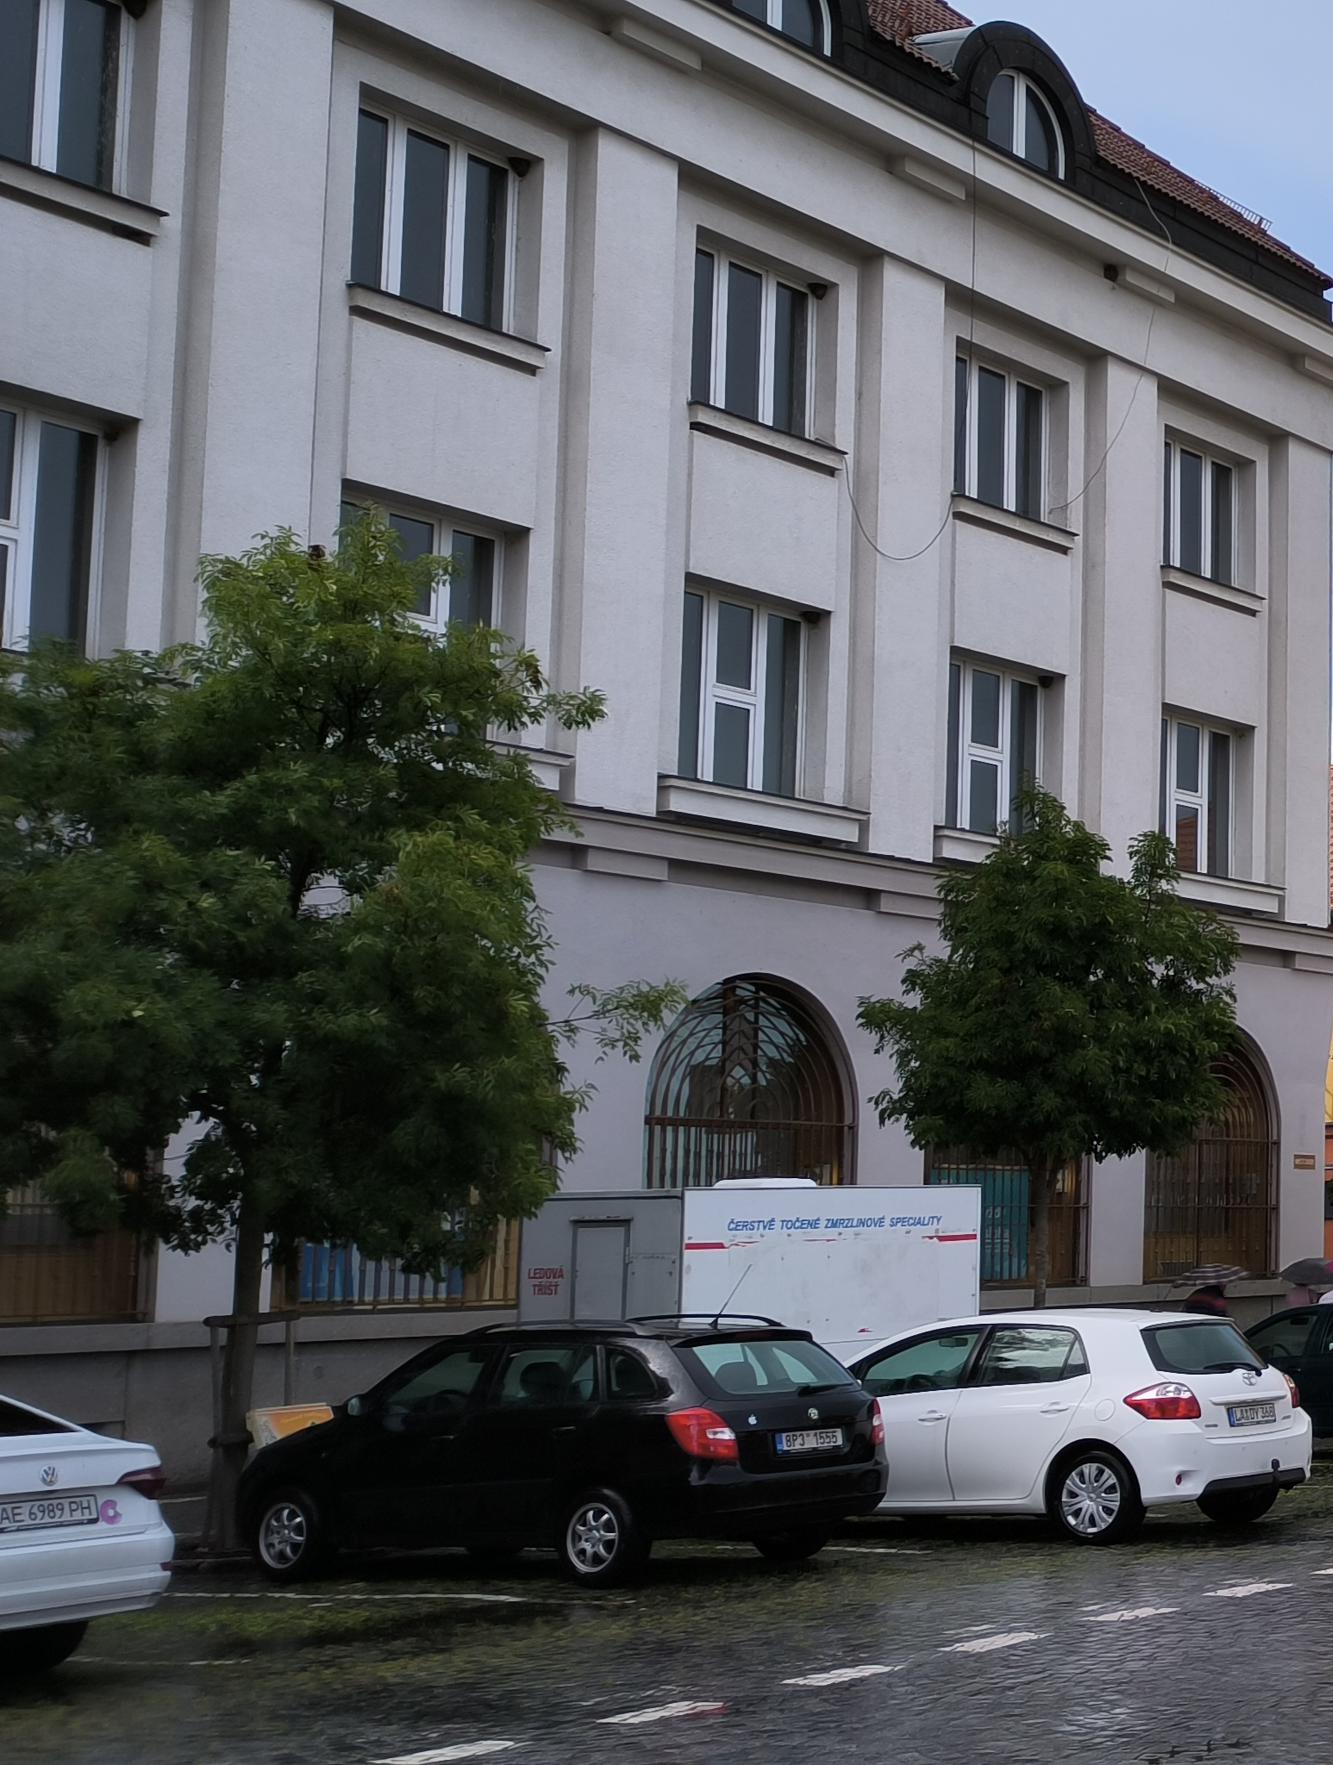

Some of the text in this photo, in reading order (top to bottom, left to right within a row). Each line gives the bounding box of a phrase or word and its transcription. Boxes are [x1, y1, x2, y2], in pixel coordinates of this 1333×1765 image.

[779, 1216, 822, 1231] TOČENÉ
[824, 1215, 886, 1230] ZMRZLINOVÉ
[888, 1214, 943, 1228] SPECIALITY
[527, 1265, 565, 1280] LEDOVÁ
[784, 1430, 838, 1448] 8P3 1555
[0, 1499, 93, 1525] AE 6989 PH
